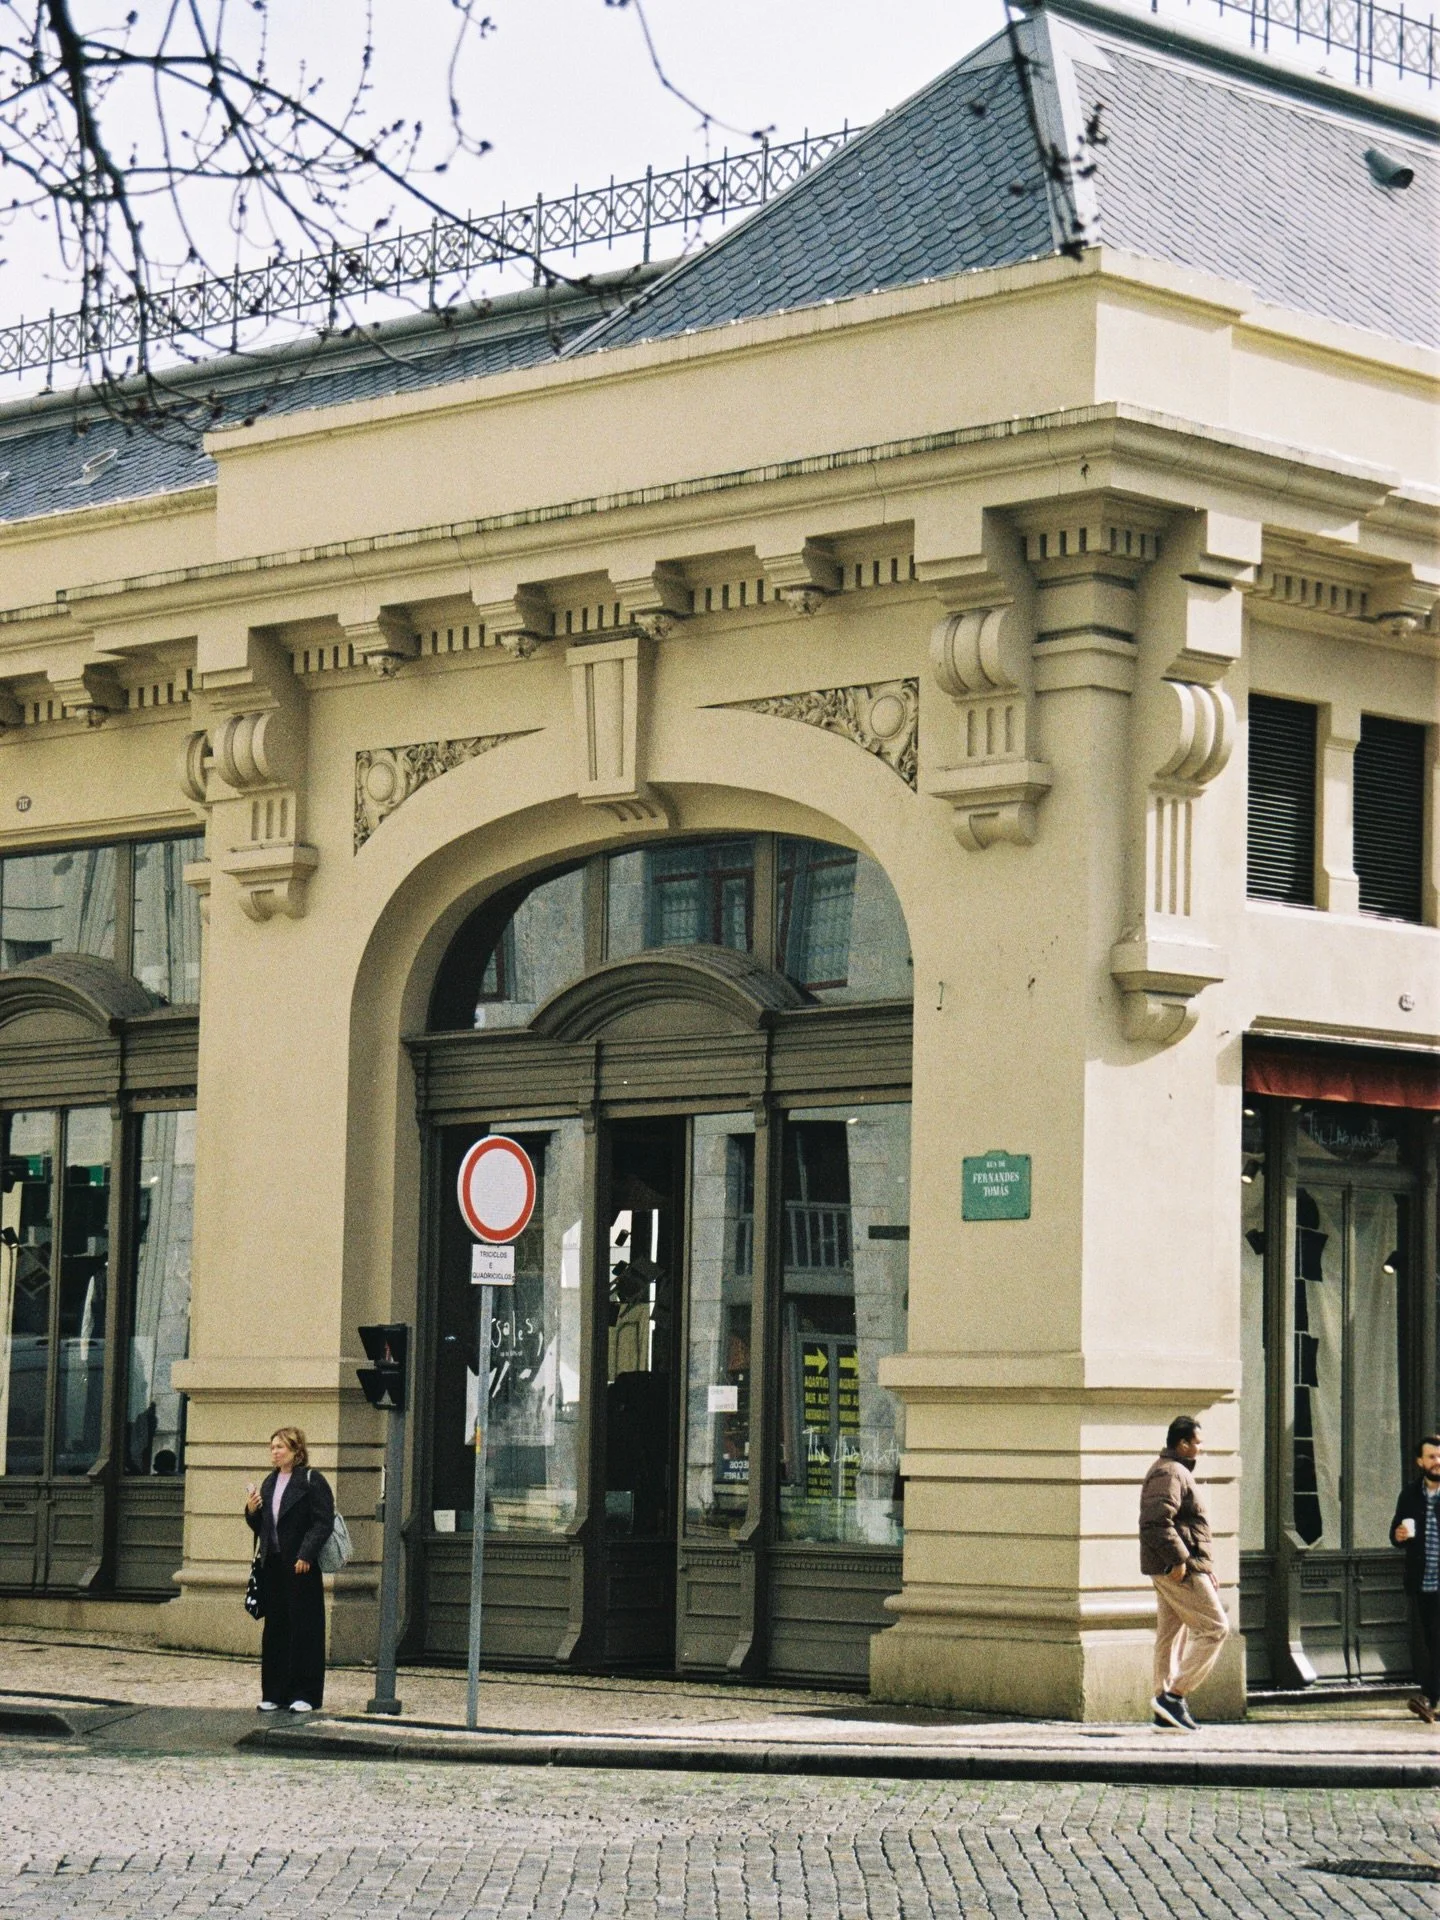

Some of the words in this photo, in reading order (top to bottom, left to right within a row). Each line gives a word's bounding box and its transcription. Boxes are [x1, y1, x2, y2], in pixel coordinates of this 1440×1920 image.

[998, 1160, 1006, 1168] DE
[973, 1171, 1020, 1184] FERNANDES
[983, 1183, 1009, 1197] TOMÁS
[480, 1250, 507, 1259] TRICICLOS
[473, 1272, 512, 1280] QUADRICICLOS
